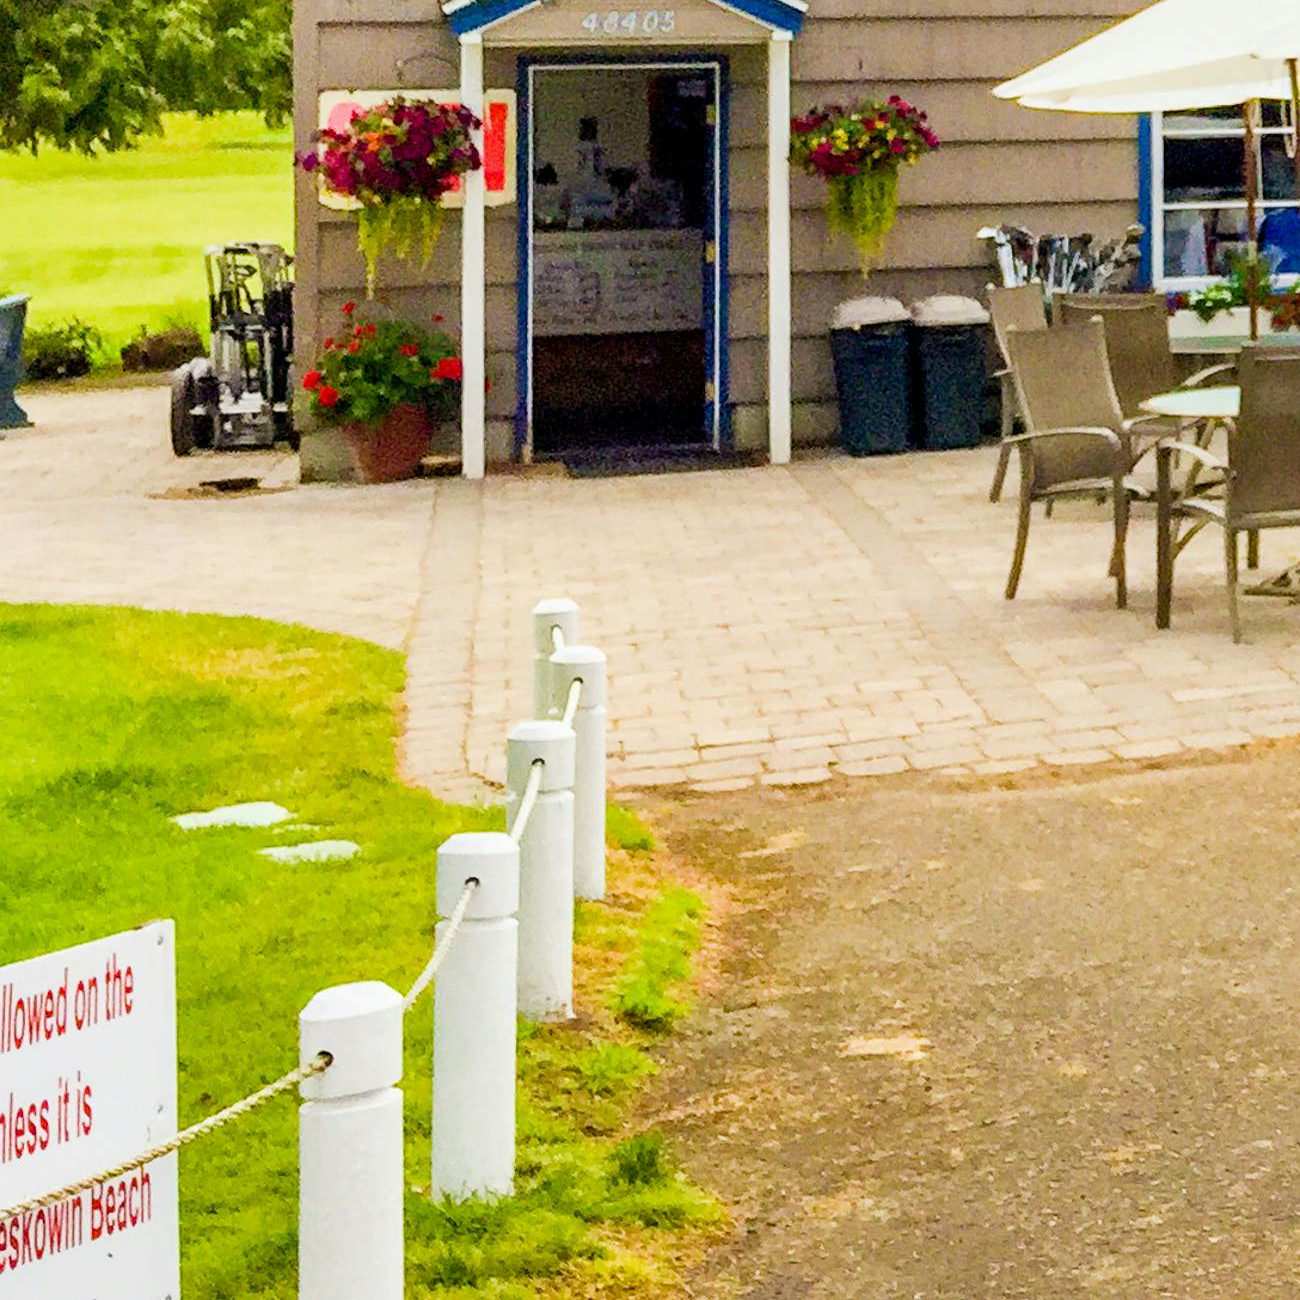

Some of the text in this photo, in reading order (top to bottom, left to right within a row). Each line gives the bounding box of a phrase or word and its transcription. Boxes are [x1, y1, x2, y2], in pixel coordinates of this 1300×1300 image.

[74, 977, 99, 1031] on
[105, 952, 135, 1021] the
[57, 1075, 70, 1145] it
[76, 1069, 93, 1137] is
[90, 1164, 152, 1241] Beach
